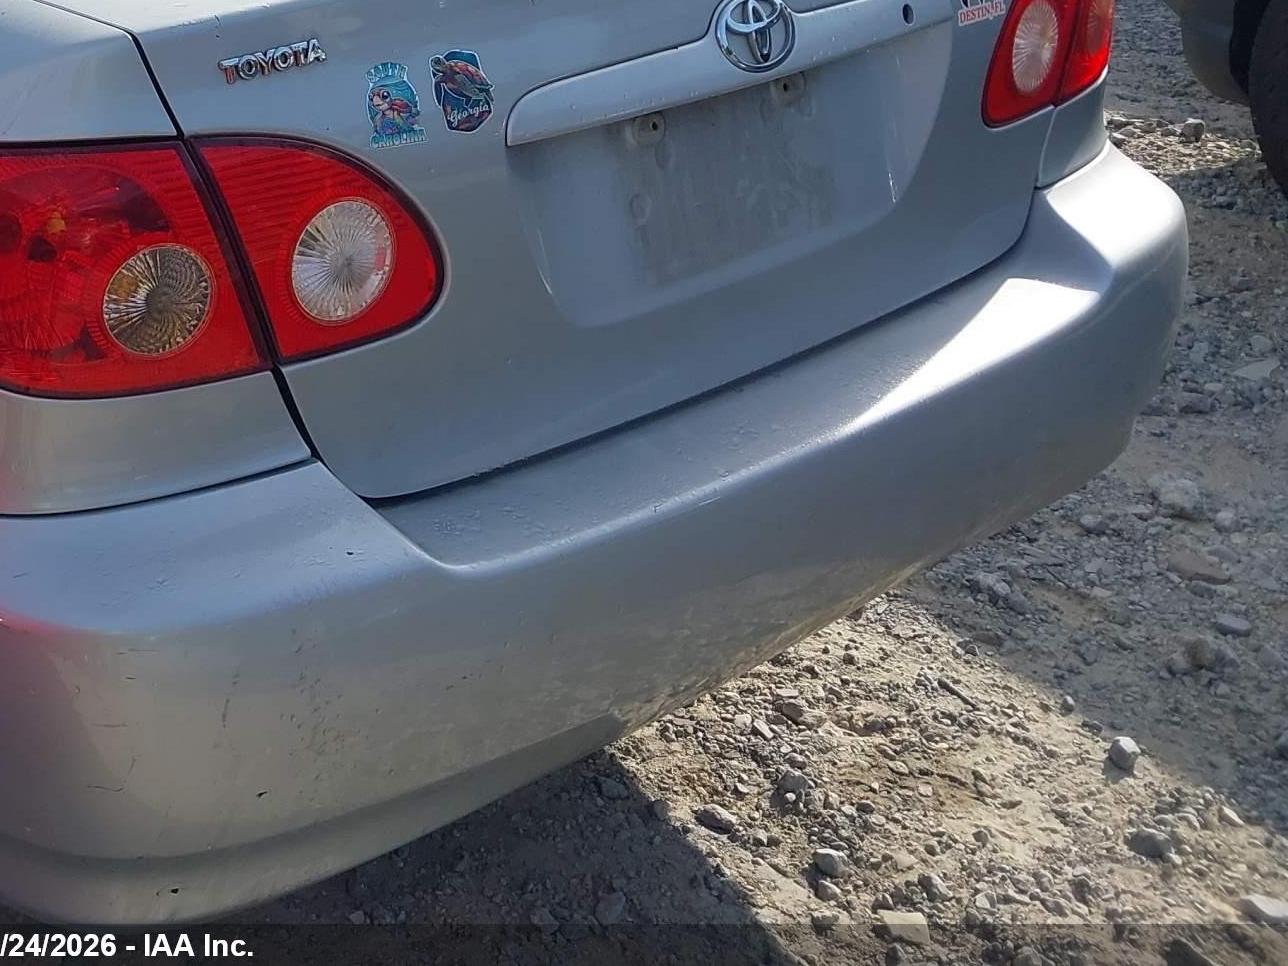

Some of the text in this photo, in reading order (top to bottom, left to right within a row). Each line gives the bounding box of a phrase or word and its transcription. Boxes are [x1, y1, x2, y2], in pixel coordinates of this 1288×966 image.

[218, 38, 327, 83] TOYOTA
[366, 62, 408, 83] SOUTH
[447, 102, 491, 127] Georgia
[371, 128, 427, 148] CAROLINA
